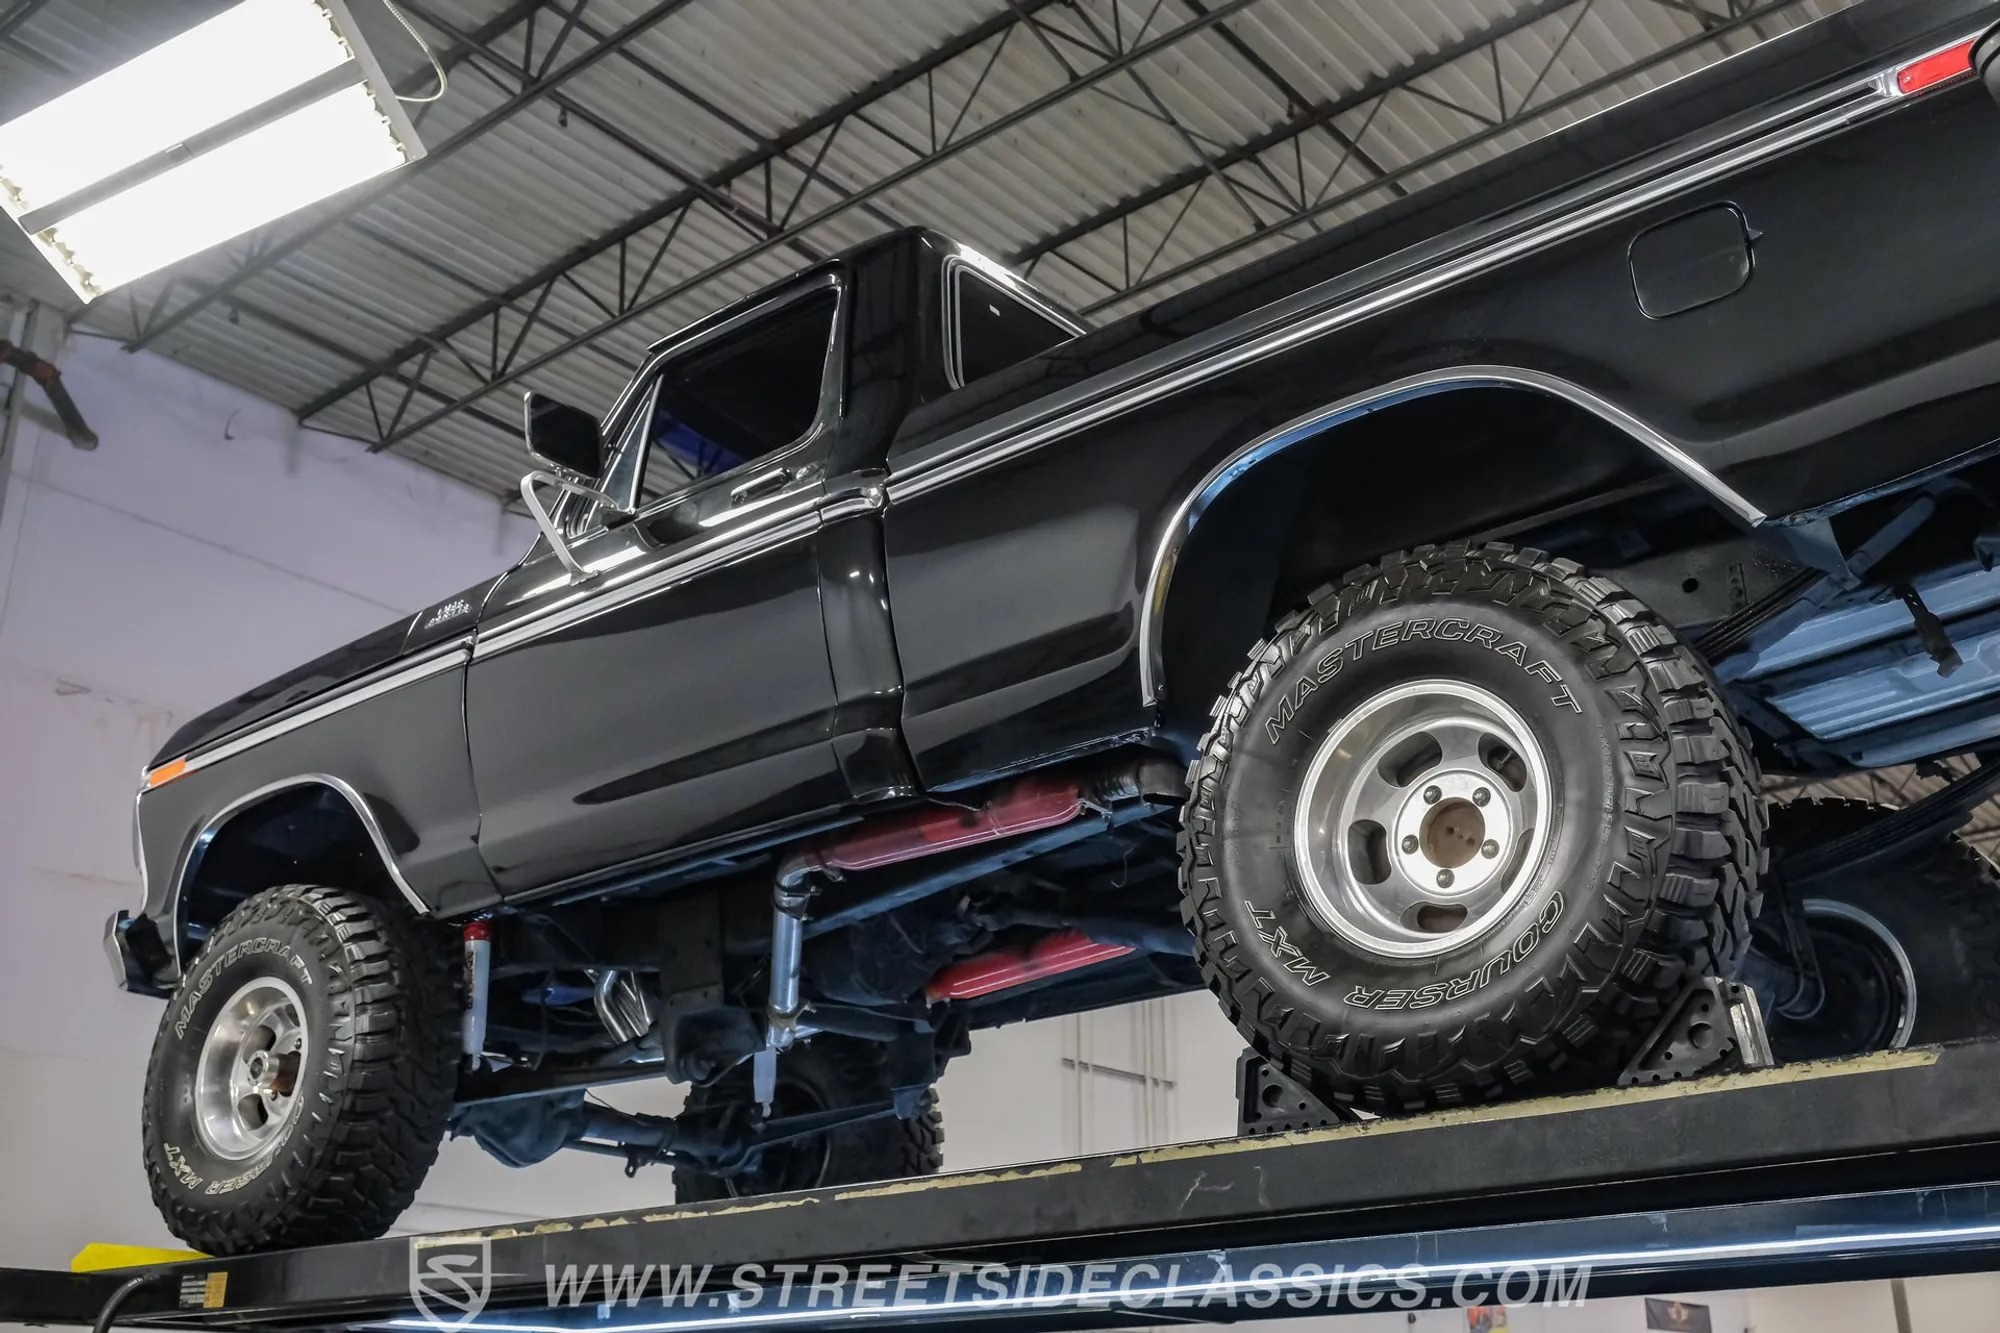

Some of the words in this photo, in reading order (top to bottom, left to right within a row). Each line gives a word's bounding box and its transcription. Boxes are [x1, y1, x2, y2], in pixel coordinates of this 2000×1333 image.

[1264, 617, 1583, 745] MASTERCRAFT
[174, 936, 313, 1040] MASTERCRAFT
[1244, 899, 1331, 987] MXT
[1343, 890, 1565, 1011] COURSER
[163, 1142, 203, 1190] MXT
